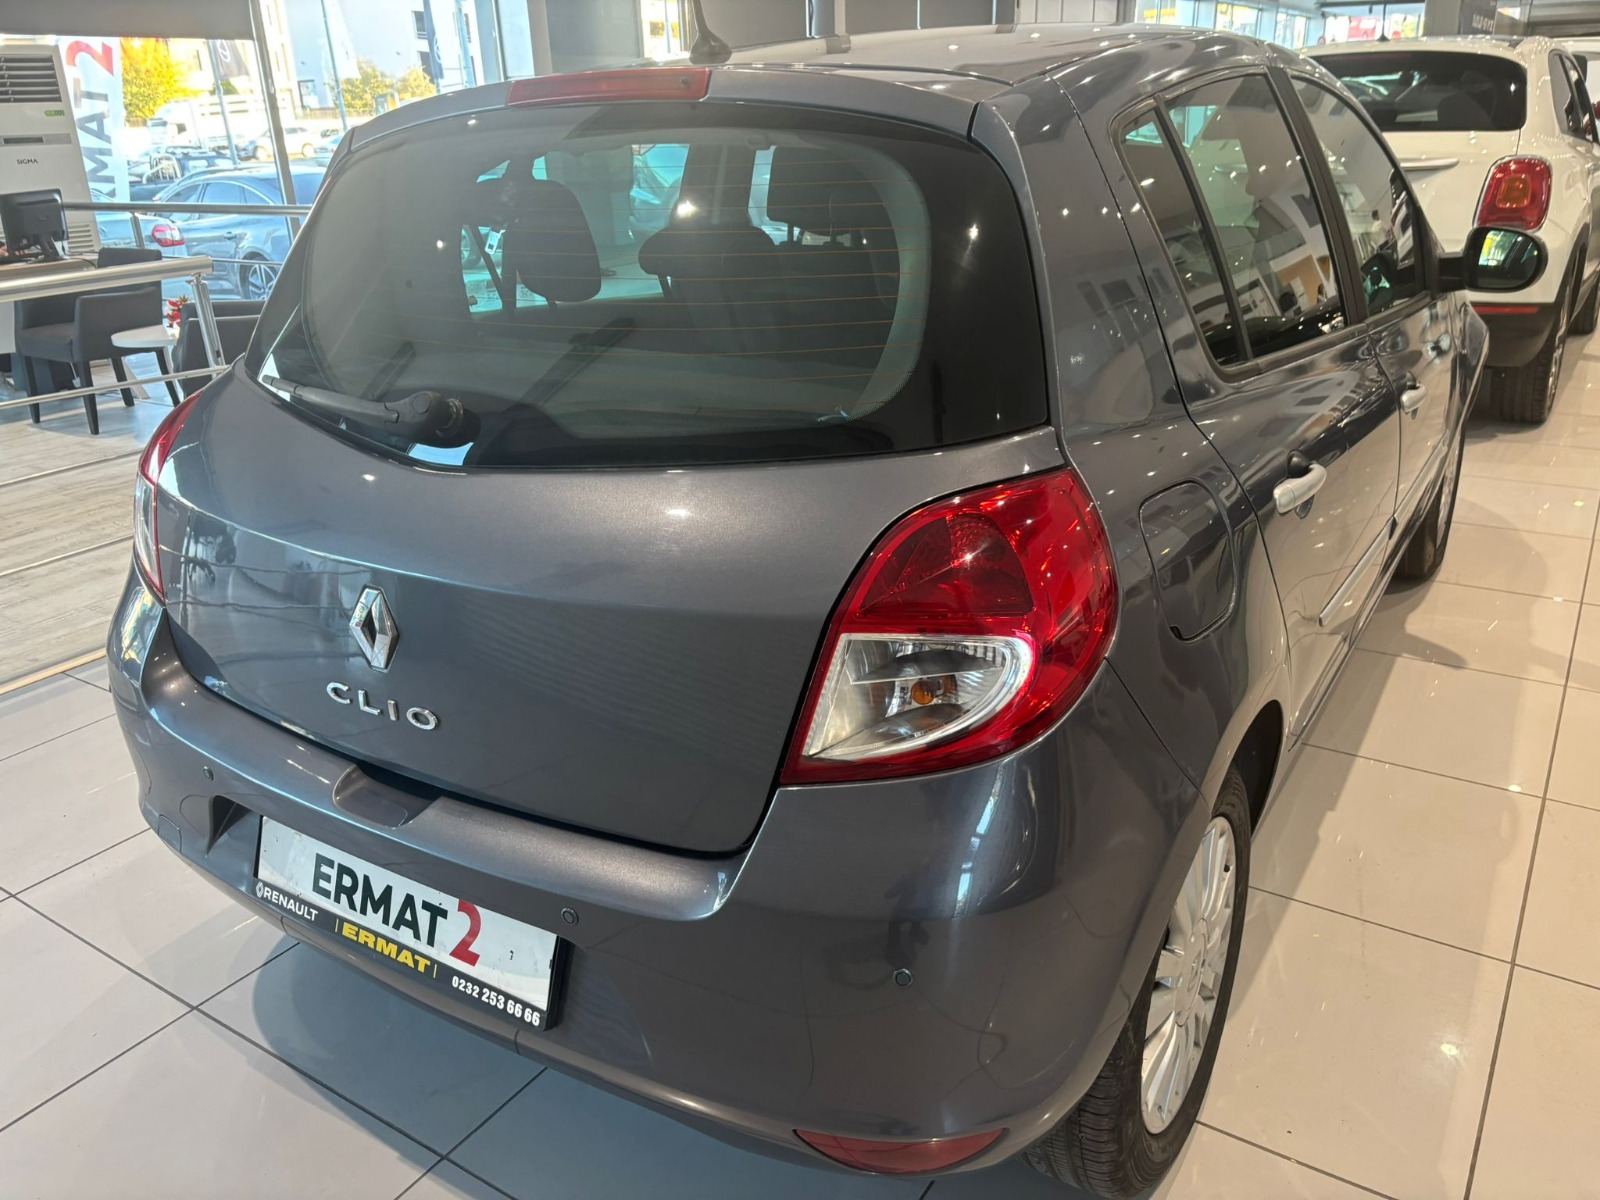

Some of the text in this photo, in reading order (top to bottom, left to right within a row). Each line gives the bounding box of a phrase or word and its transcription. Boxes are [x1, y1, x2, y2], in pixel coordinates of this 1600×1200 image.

[326, 682, 438, 730] CLIO
[263, 886, 319, 922] RENAULT
[342, 922, 431, 973] ERMAT
[451, 975, 480, 999] 0232
[481, 987, 505, 1010] 253
